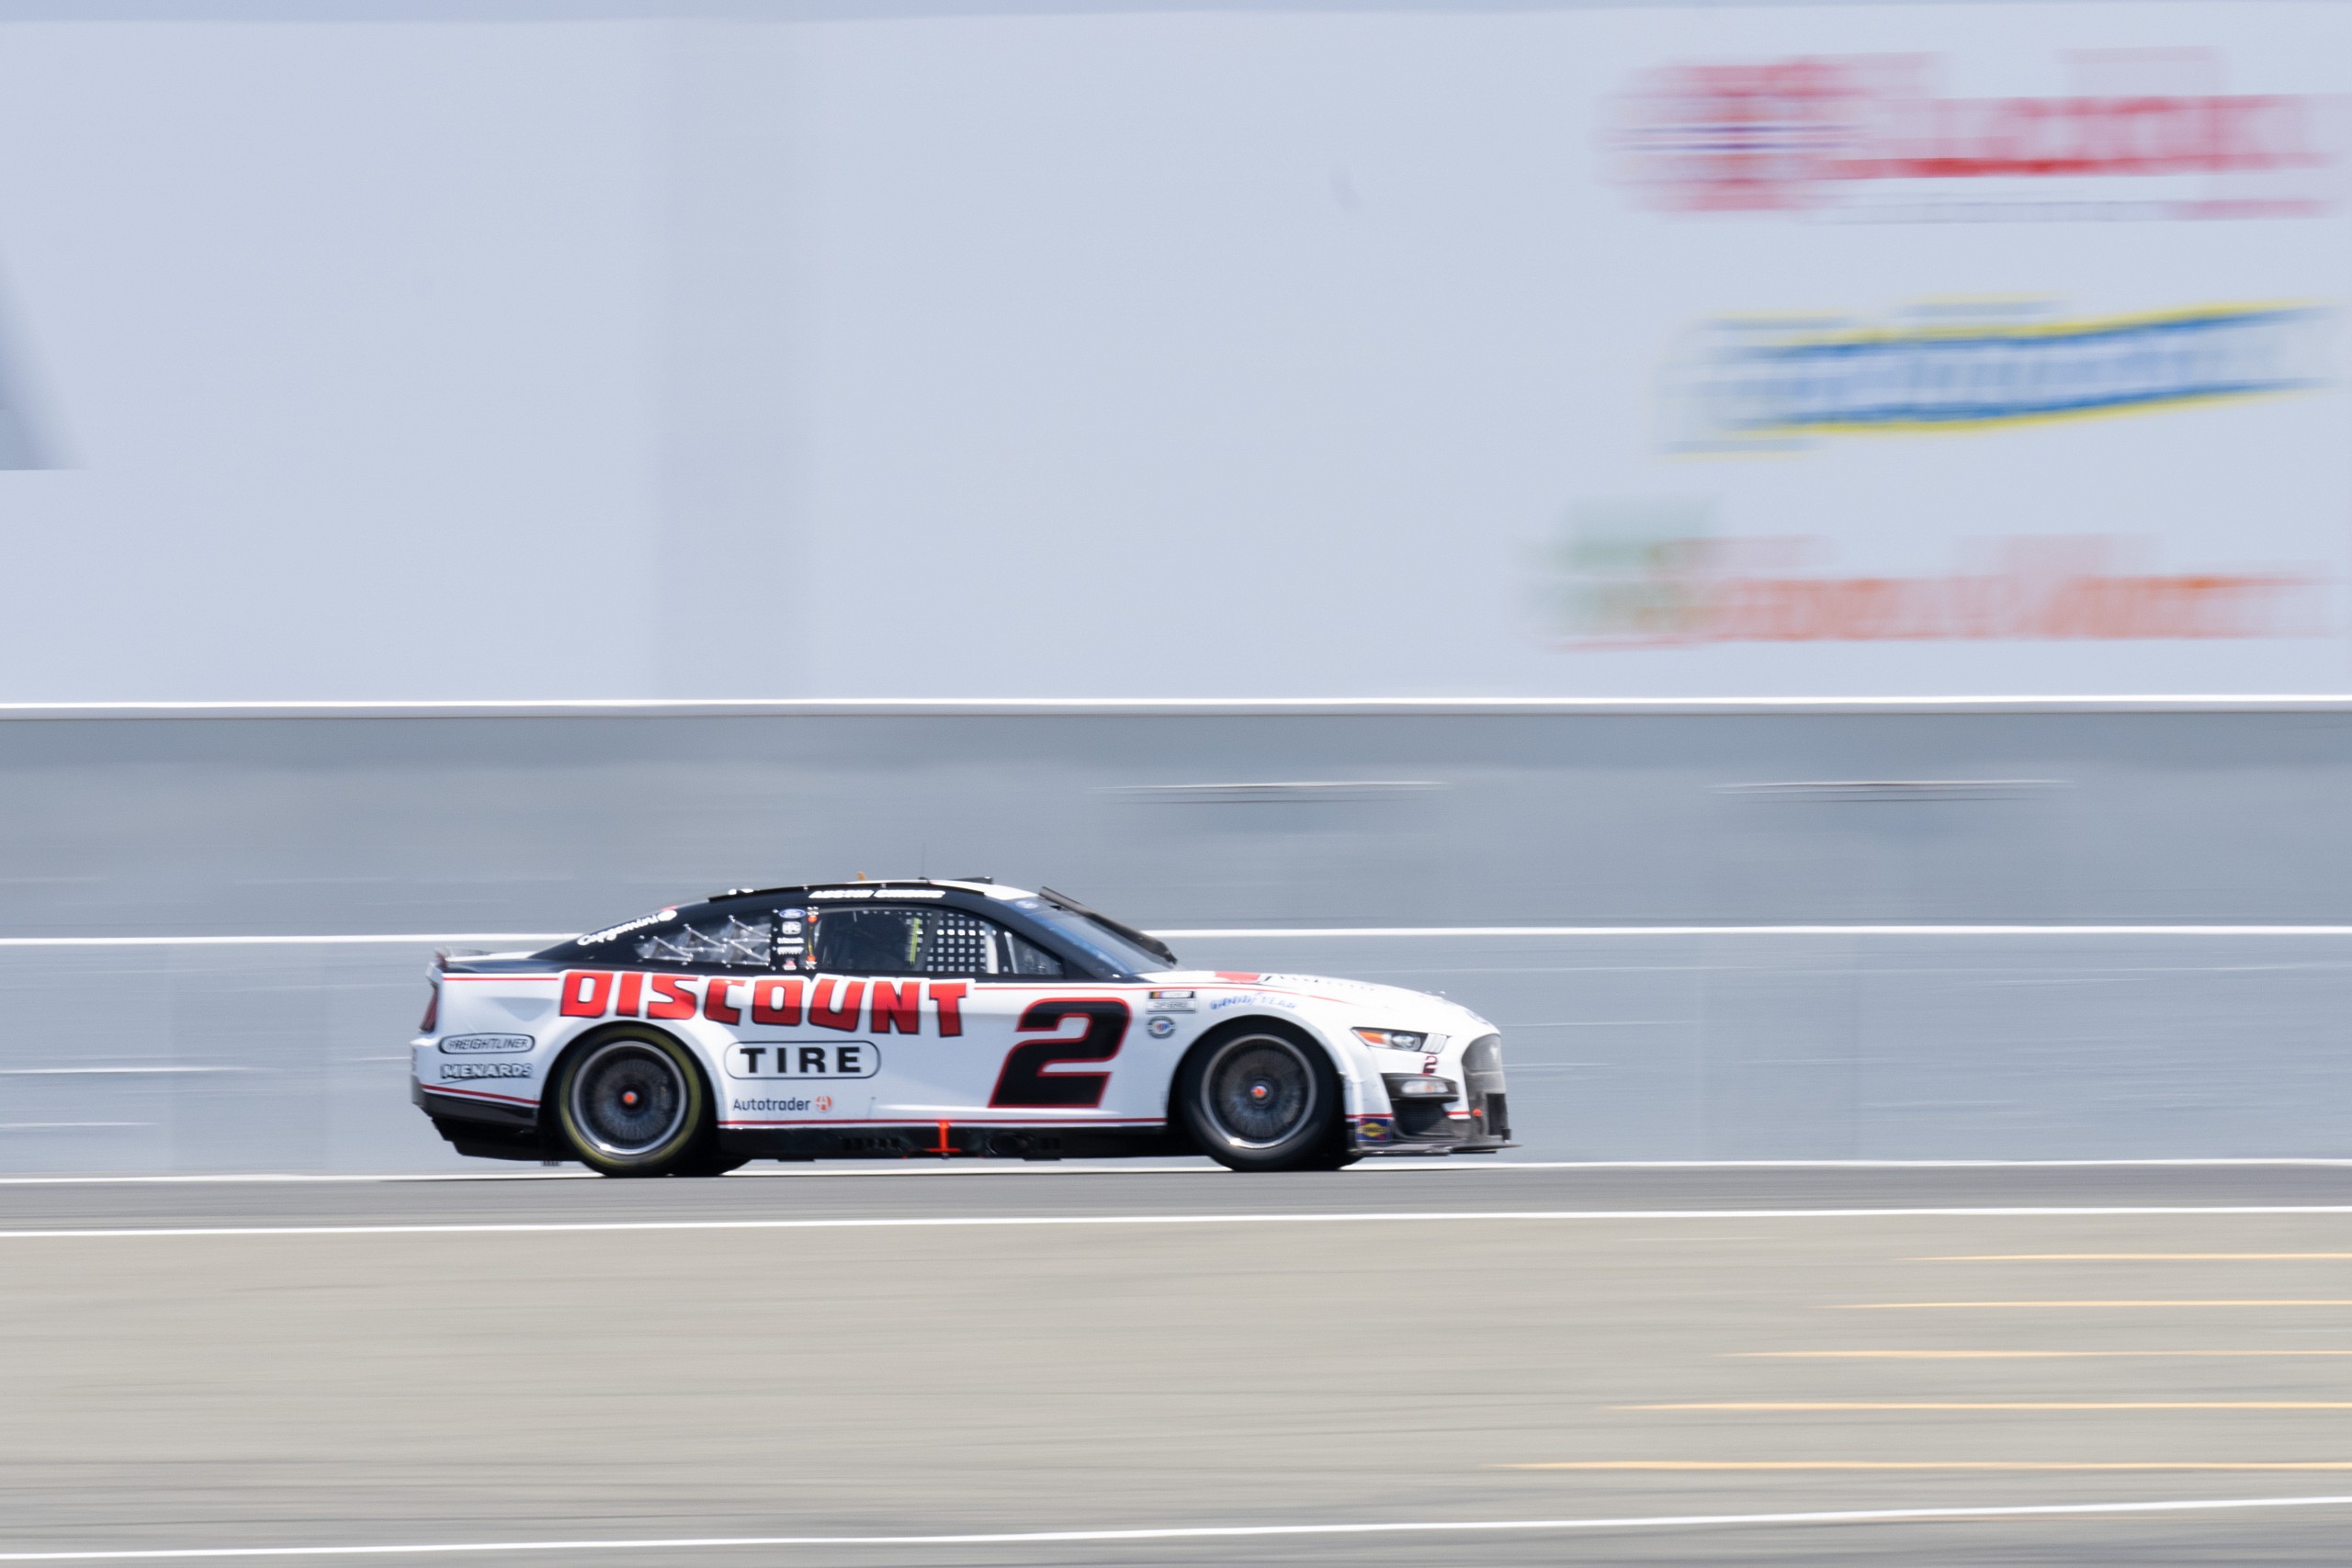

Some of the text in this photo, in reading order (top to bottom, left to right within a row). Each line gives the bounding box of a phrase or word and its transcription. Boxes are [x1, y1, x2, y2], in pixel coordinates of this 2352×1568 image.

[559, 970, 968, 1038] DISCOUNT
[447, 1037, 529, 1051] FREIGHTLINER
[988, 997, 1132, 1110] 2
[441, 1062, 533, 1079] MENARDS
[739, 1046, 862, 1074] TIRE
[1420, 1055, 1438, 1076] 2
[732, 1097, 811, 1111] Autotrader
